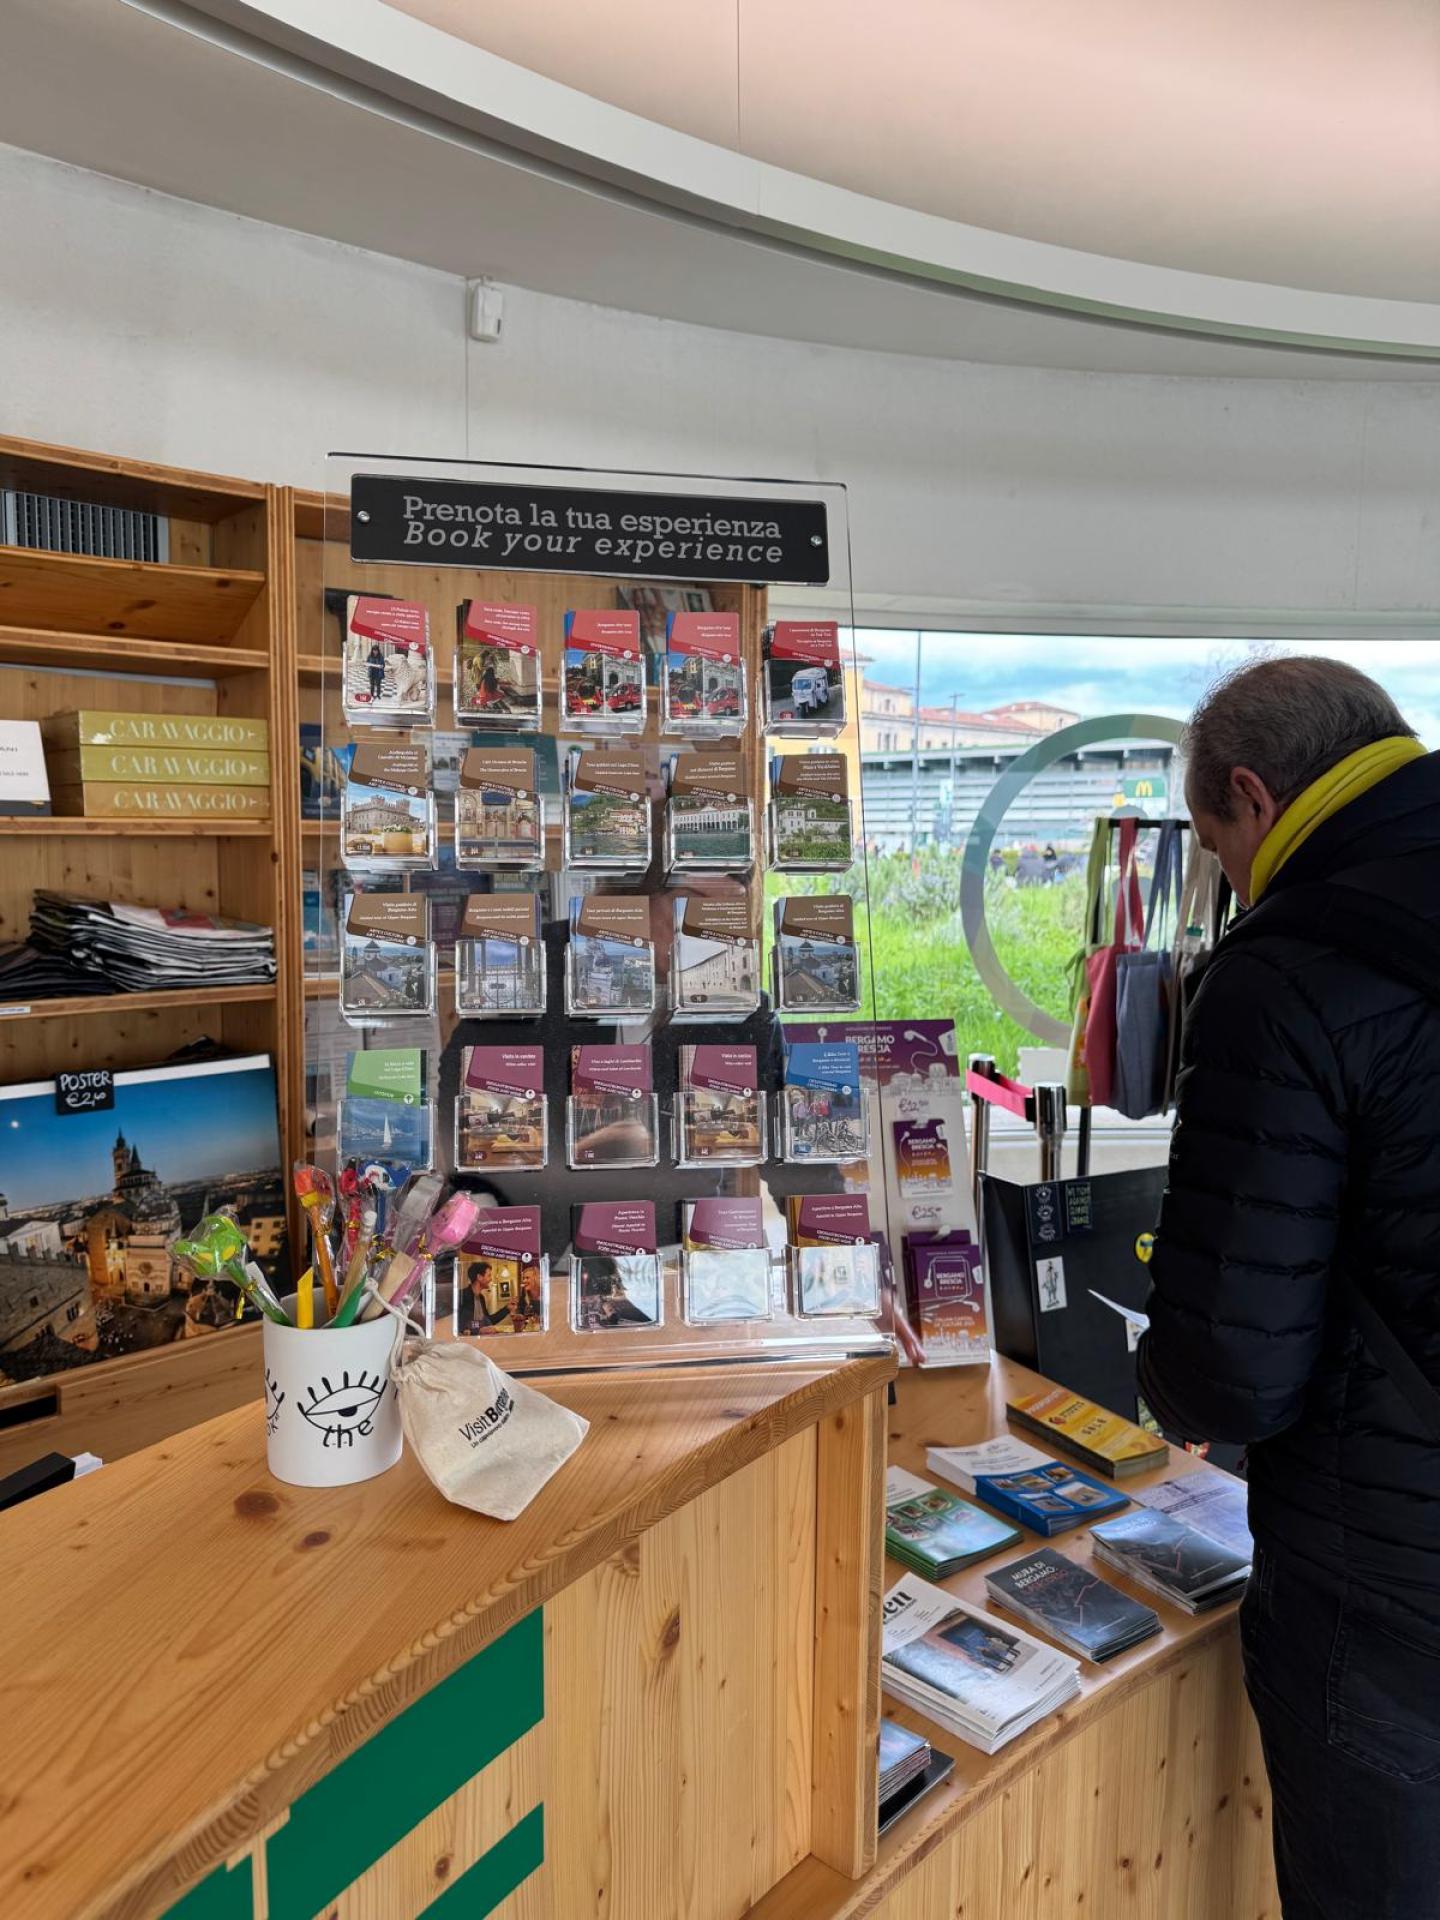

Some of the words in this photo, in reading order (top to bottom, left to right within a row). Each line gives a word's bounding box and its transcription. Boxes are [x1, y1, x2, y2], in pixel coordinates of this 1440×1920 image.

[403, 495, 523, 527] Prenota
[529, 503, 558, 528] la
[565, 507, 613, 532] tua
[620, 512, 781, 540] esperienza
[404, 524, 494, 549] Book
[502, 531, 581, 557] your
[594, 536, 784, 565] experience
[109, 719, 245, 743] CARAVAGGIO
[111, 754, 247, 777] CARAVAGGIO
[113, 790, 247, 811] CARAVAGGIO
[845, 1034, 896, 1045] BERGAMO
[858, 1044, 893, 1054] RESCIA
[60, 1071, 112, 1092] POSTER
[323, 1420, 374, 1448] the
